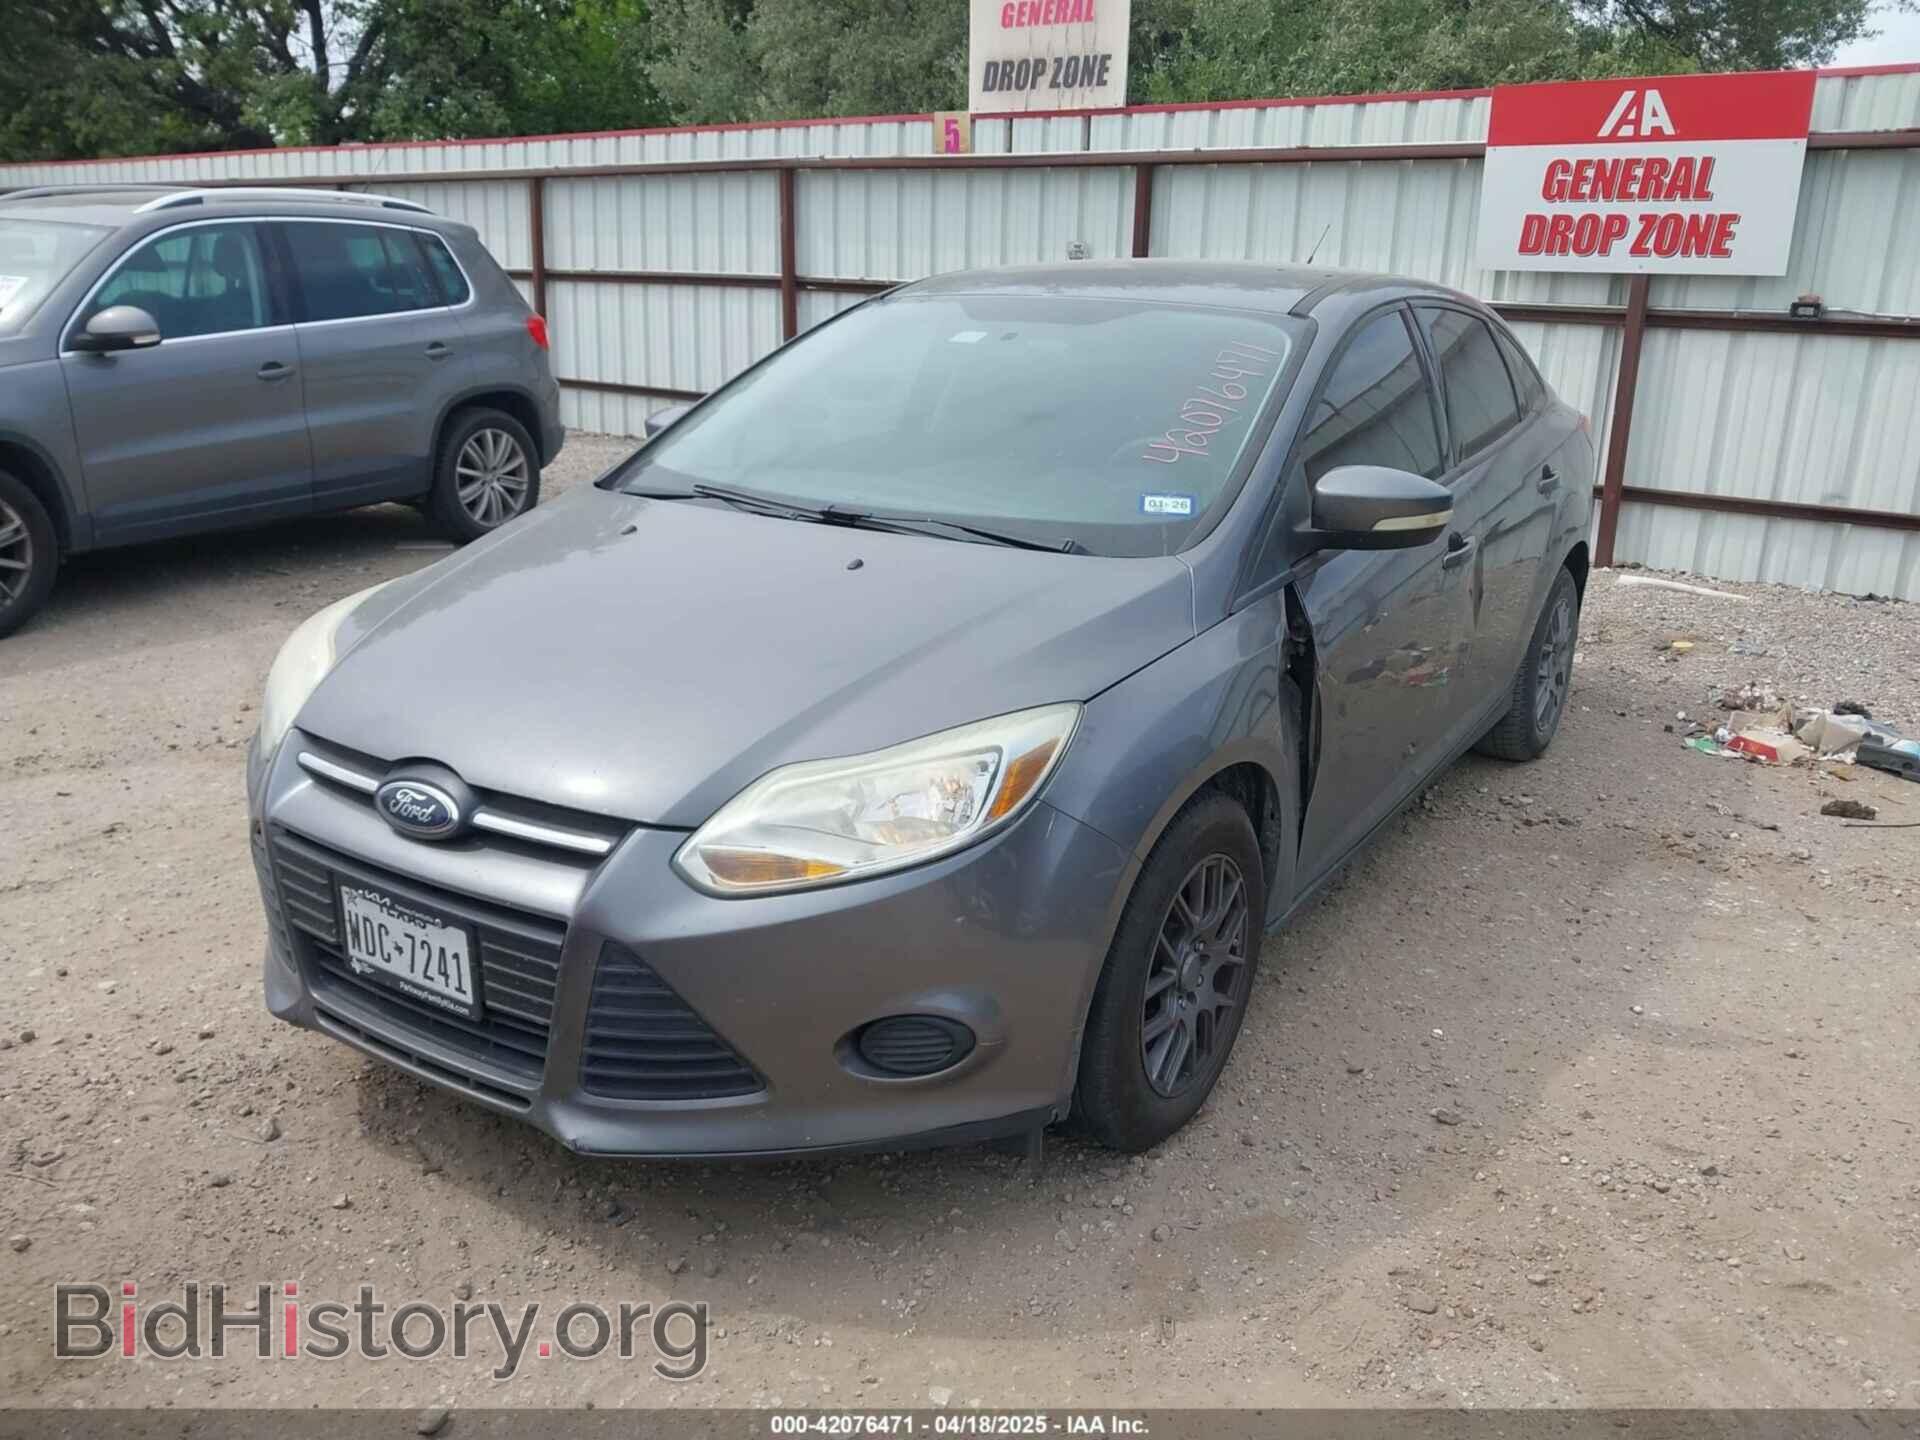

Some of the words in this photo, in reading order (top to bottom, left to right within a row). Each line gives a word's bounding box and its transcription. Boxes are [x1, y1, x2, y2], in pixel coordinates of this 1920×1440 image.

[1001, 0, 1095, 28] GENERAL
[982, 57, 1047, 92] DROP
[1049, 54, 1112, 88] ZONE
[943, 118, 960, 153] 5
[1541, 156, 1716, 203] GENERAL
[1518, 212, 1630, 257] DROP
[1628, 212, 1741, 258] ZONE
[389, 788, 436, 823] Ford
[403, 932, 467, 995] 7241
